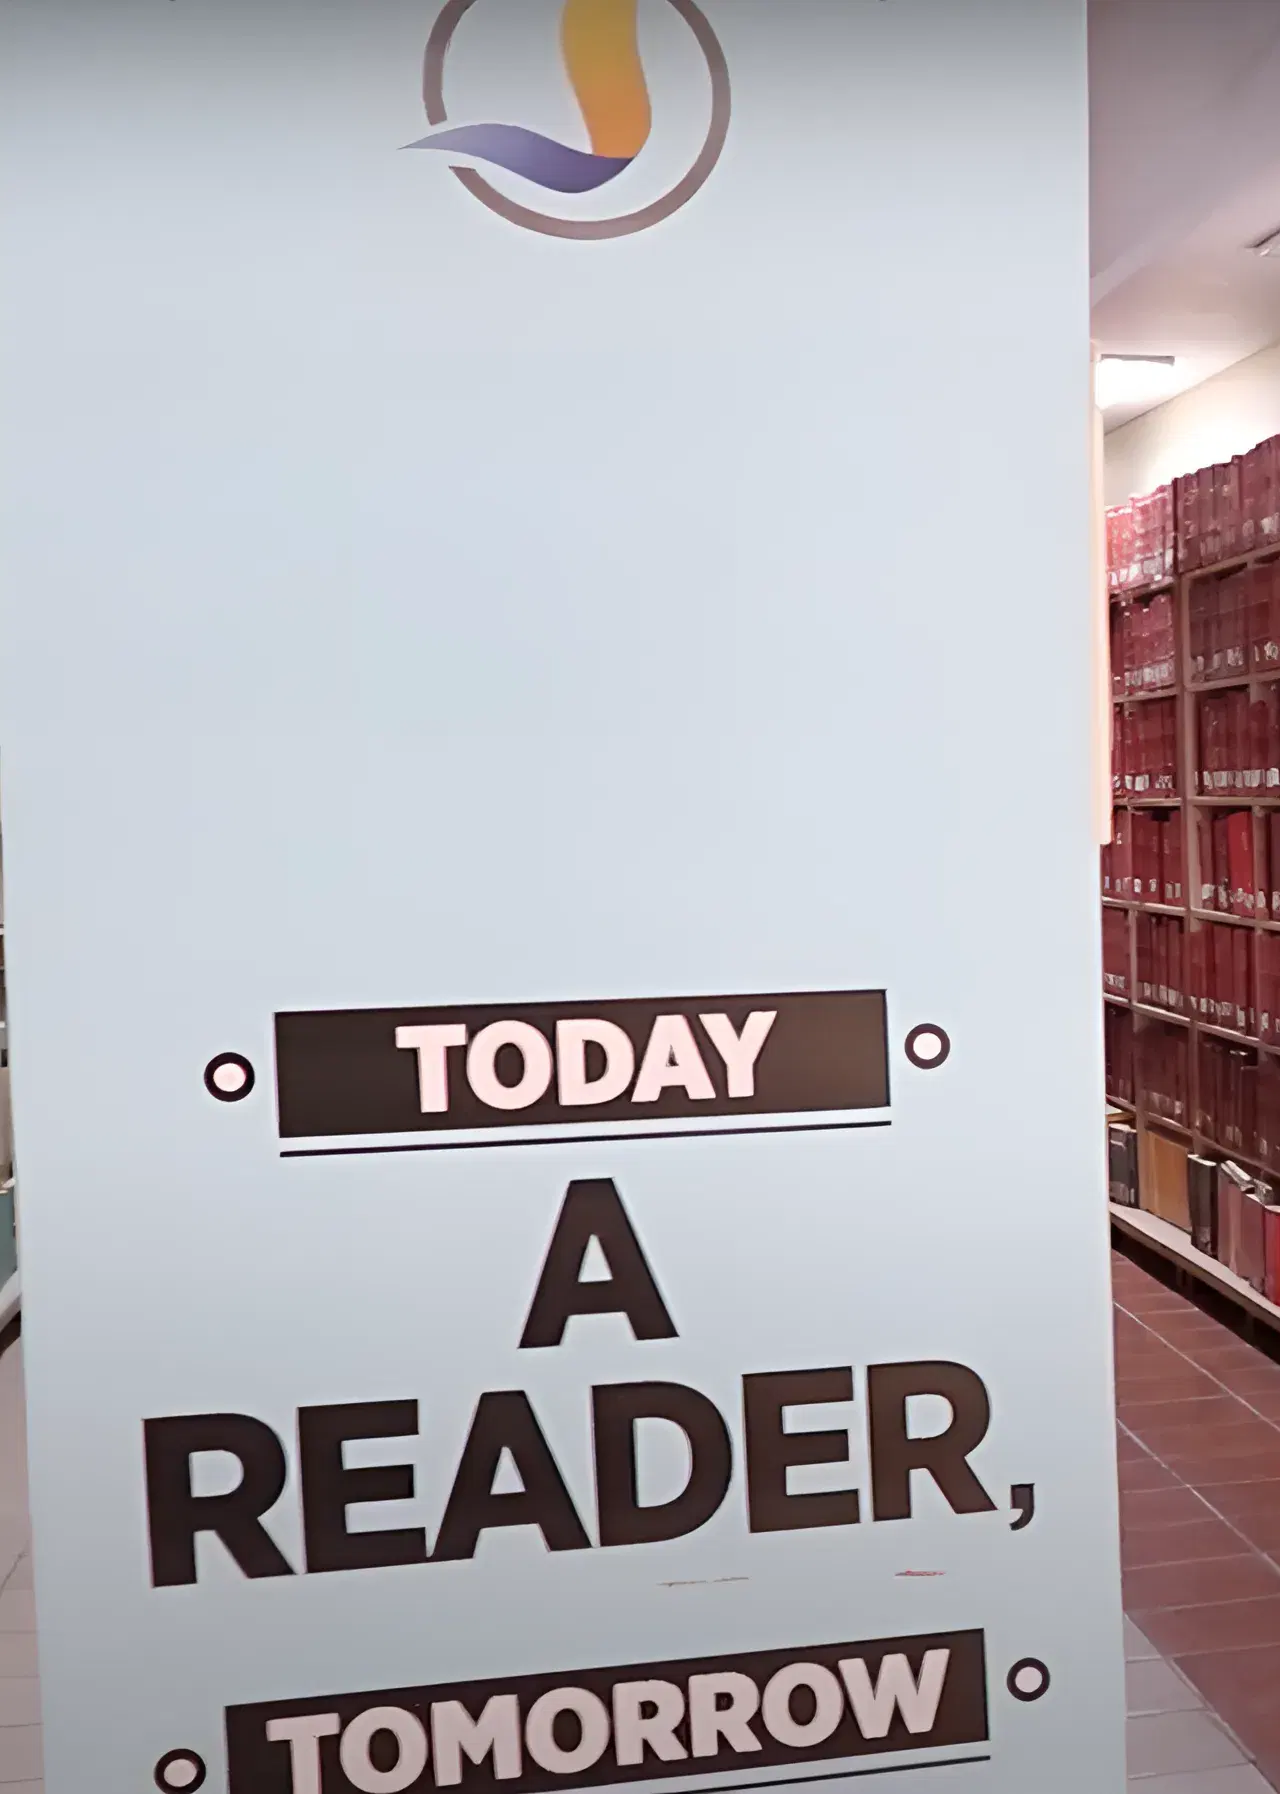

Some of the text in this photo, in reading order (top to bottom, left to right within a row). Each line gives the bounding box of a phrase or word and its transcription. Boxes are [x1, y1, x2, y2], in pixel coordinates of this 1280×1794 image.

[396, 1010, 778, 1113] TODAY
[518, 1178, 680, 1349] A
[143, 1361, 1038, 1589] READER,
[266, 1648, 950, 1794] TOMORROW
